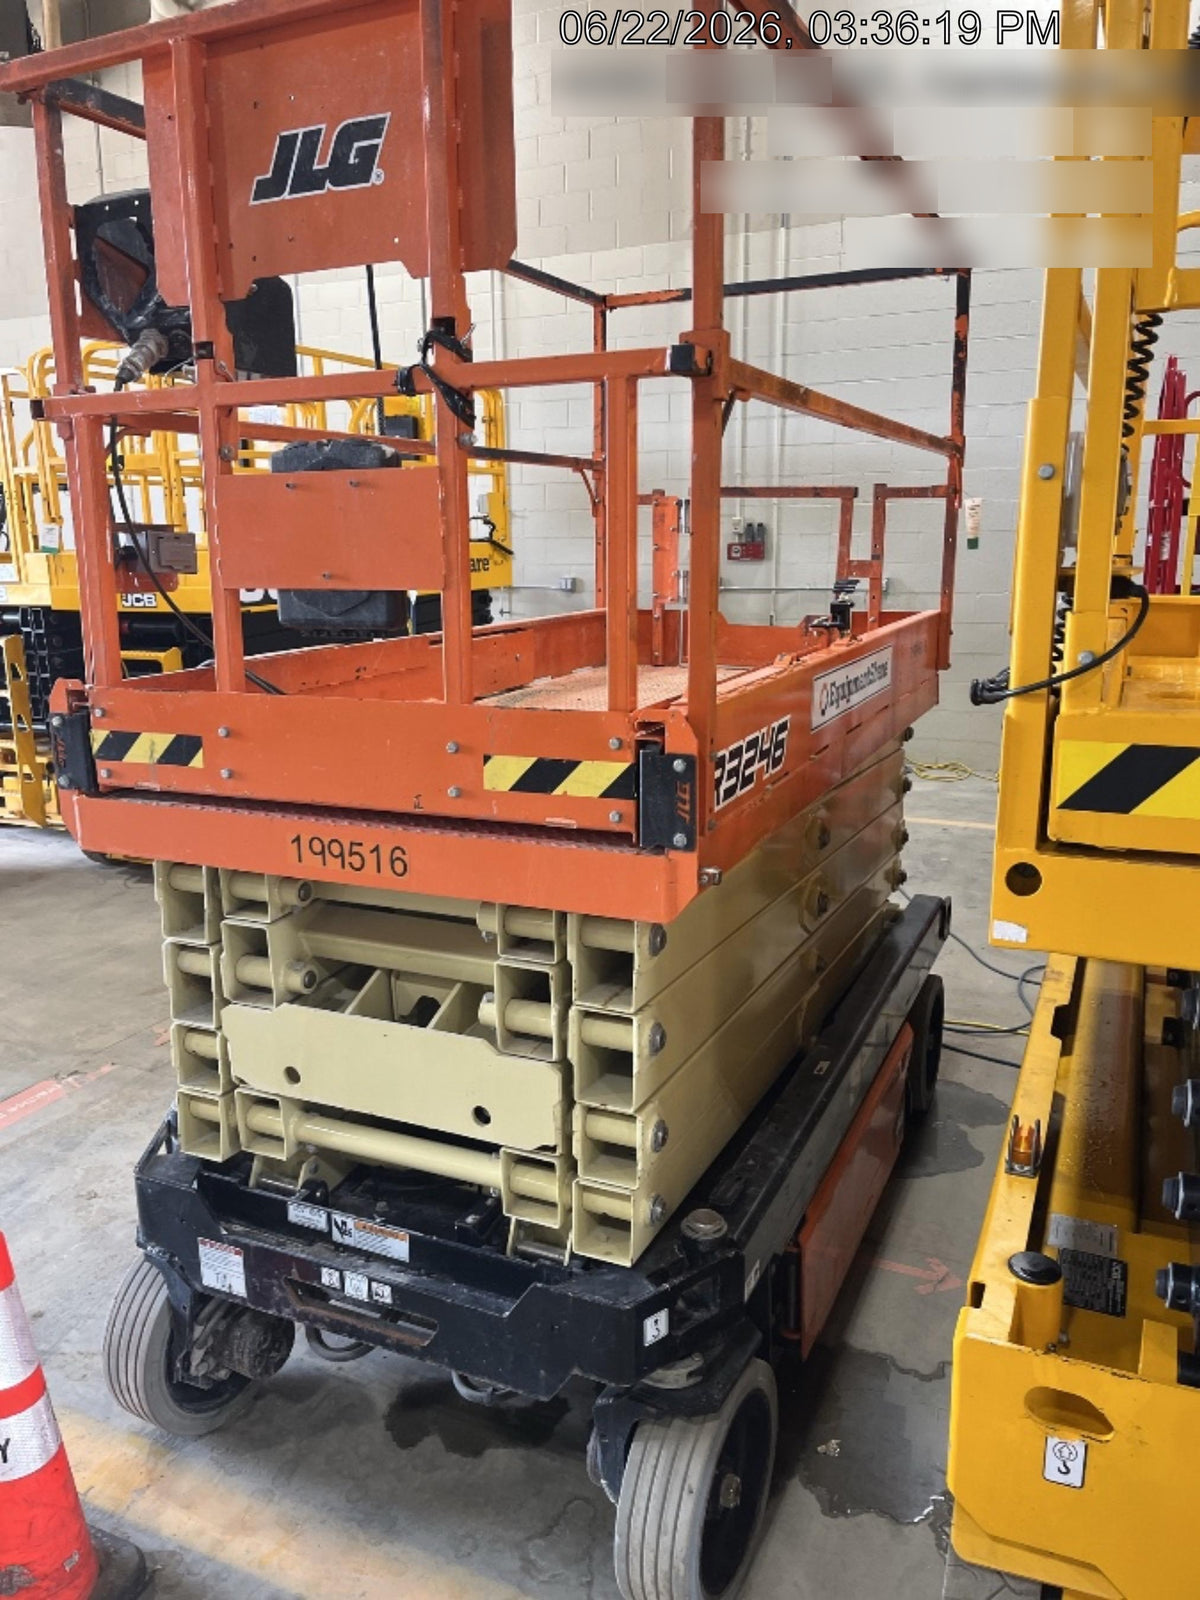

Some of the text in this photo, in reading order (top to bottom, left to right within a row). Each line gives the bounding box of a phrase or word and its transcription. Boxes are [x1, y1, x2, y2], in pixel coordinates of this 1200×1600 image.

[250, 112, 391, 206] JLG
[121, 593, 157, 607] JCB
[676, 780, 691, 824] JLG
[290, 834, 408, 878] 199516
